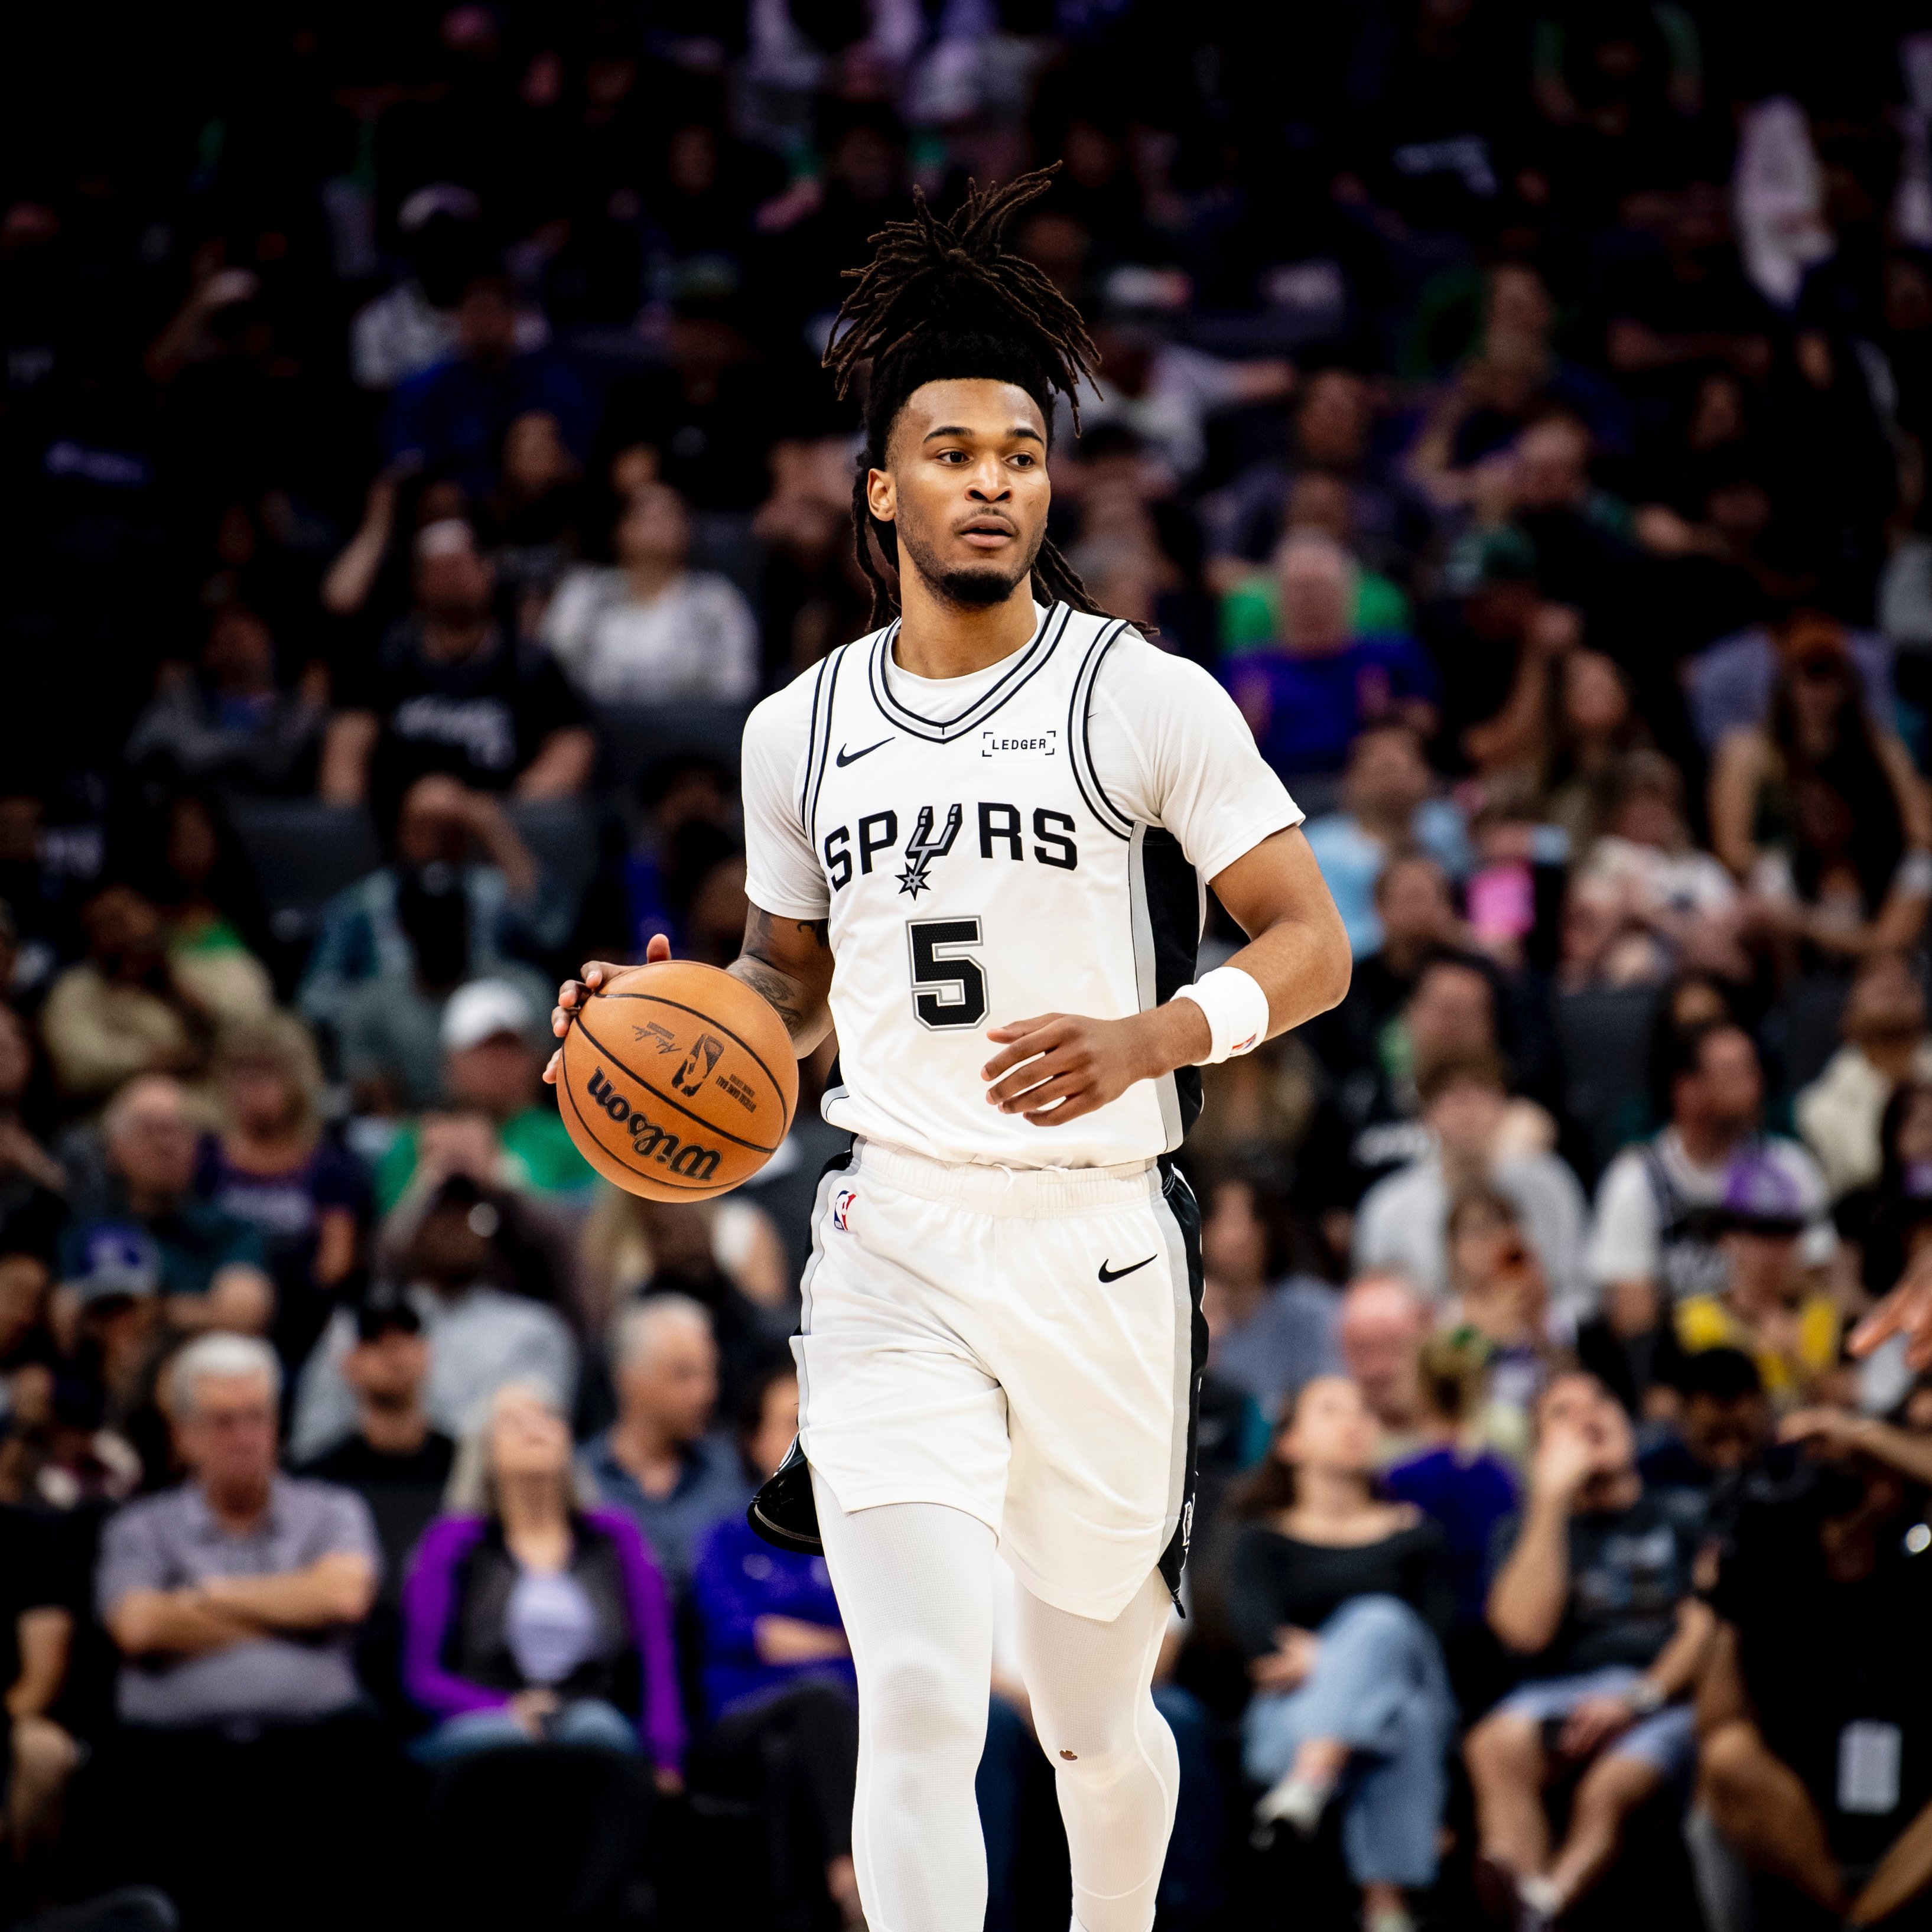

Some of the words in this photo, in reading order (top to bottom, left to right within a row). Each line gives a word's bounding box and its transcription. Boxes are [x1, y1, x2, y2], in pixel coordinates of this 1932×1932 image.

[992, 739, 1046, 750] LEDGER
[824, 802, 1078, 902] SPURS
[906, 915, 990, 1032] 5
[587, 1066, 722, 1181] Wilson
